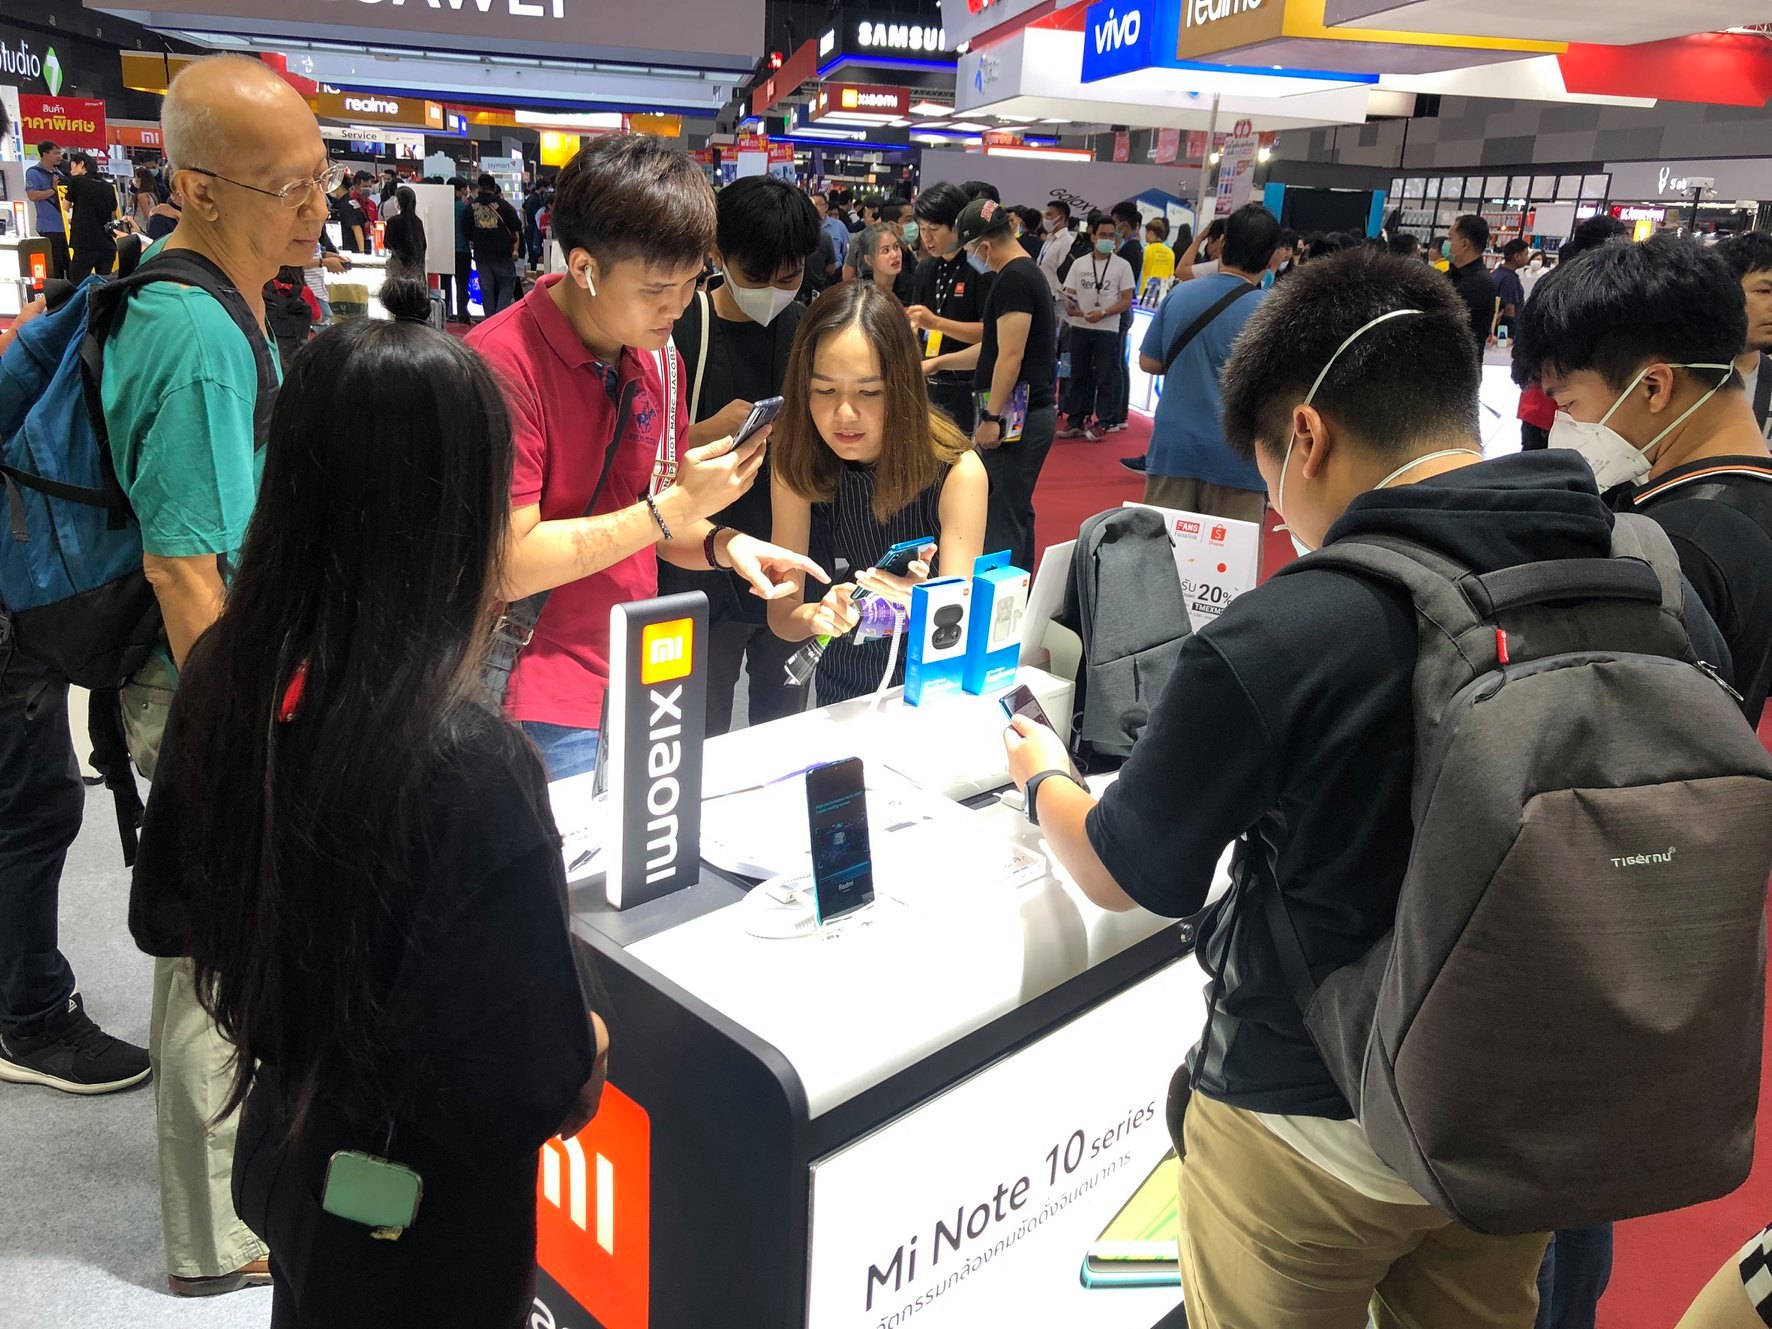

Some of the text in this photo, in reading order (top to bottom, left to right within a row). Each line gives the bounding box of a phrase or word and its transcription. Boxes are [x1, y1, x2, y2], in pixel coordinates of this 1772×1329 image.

[1095, 8, 1140, 54] vivo
[0, 40, 41, 78] tudio
[345, 97, 399, 115] realme
[21, 115, 96, 133] าคาพิเศษ
[341, 129, 377, 141] Service
[1049, 188, 1098, 216] Galaxy
[669, 345, 677, 396] JACOBS
[866, 1100, 1156, 1312] Mi Note 10 series
